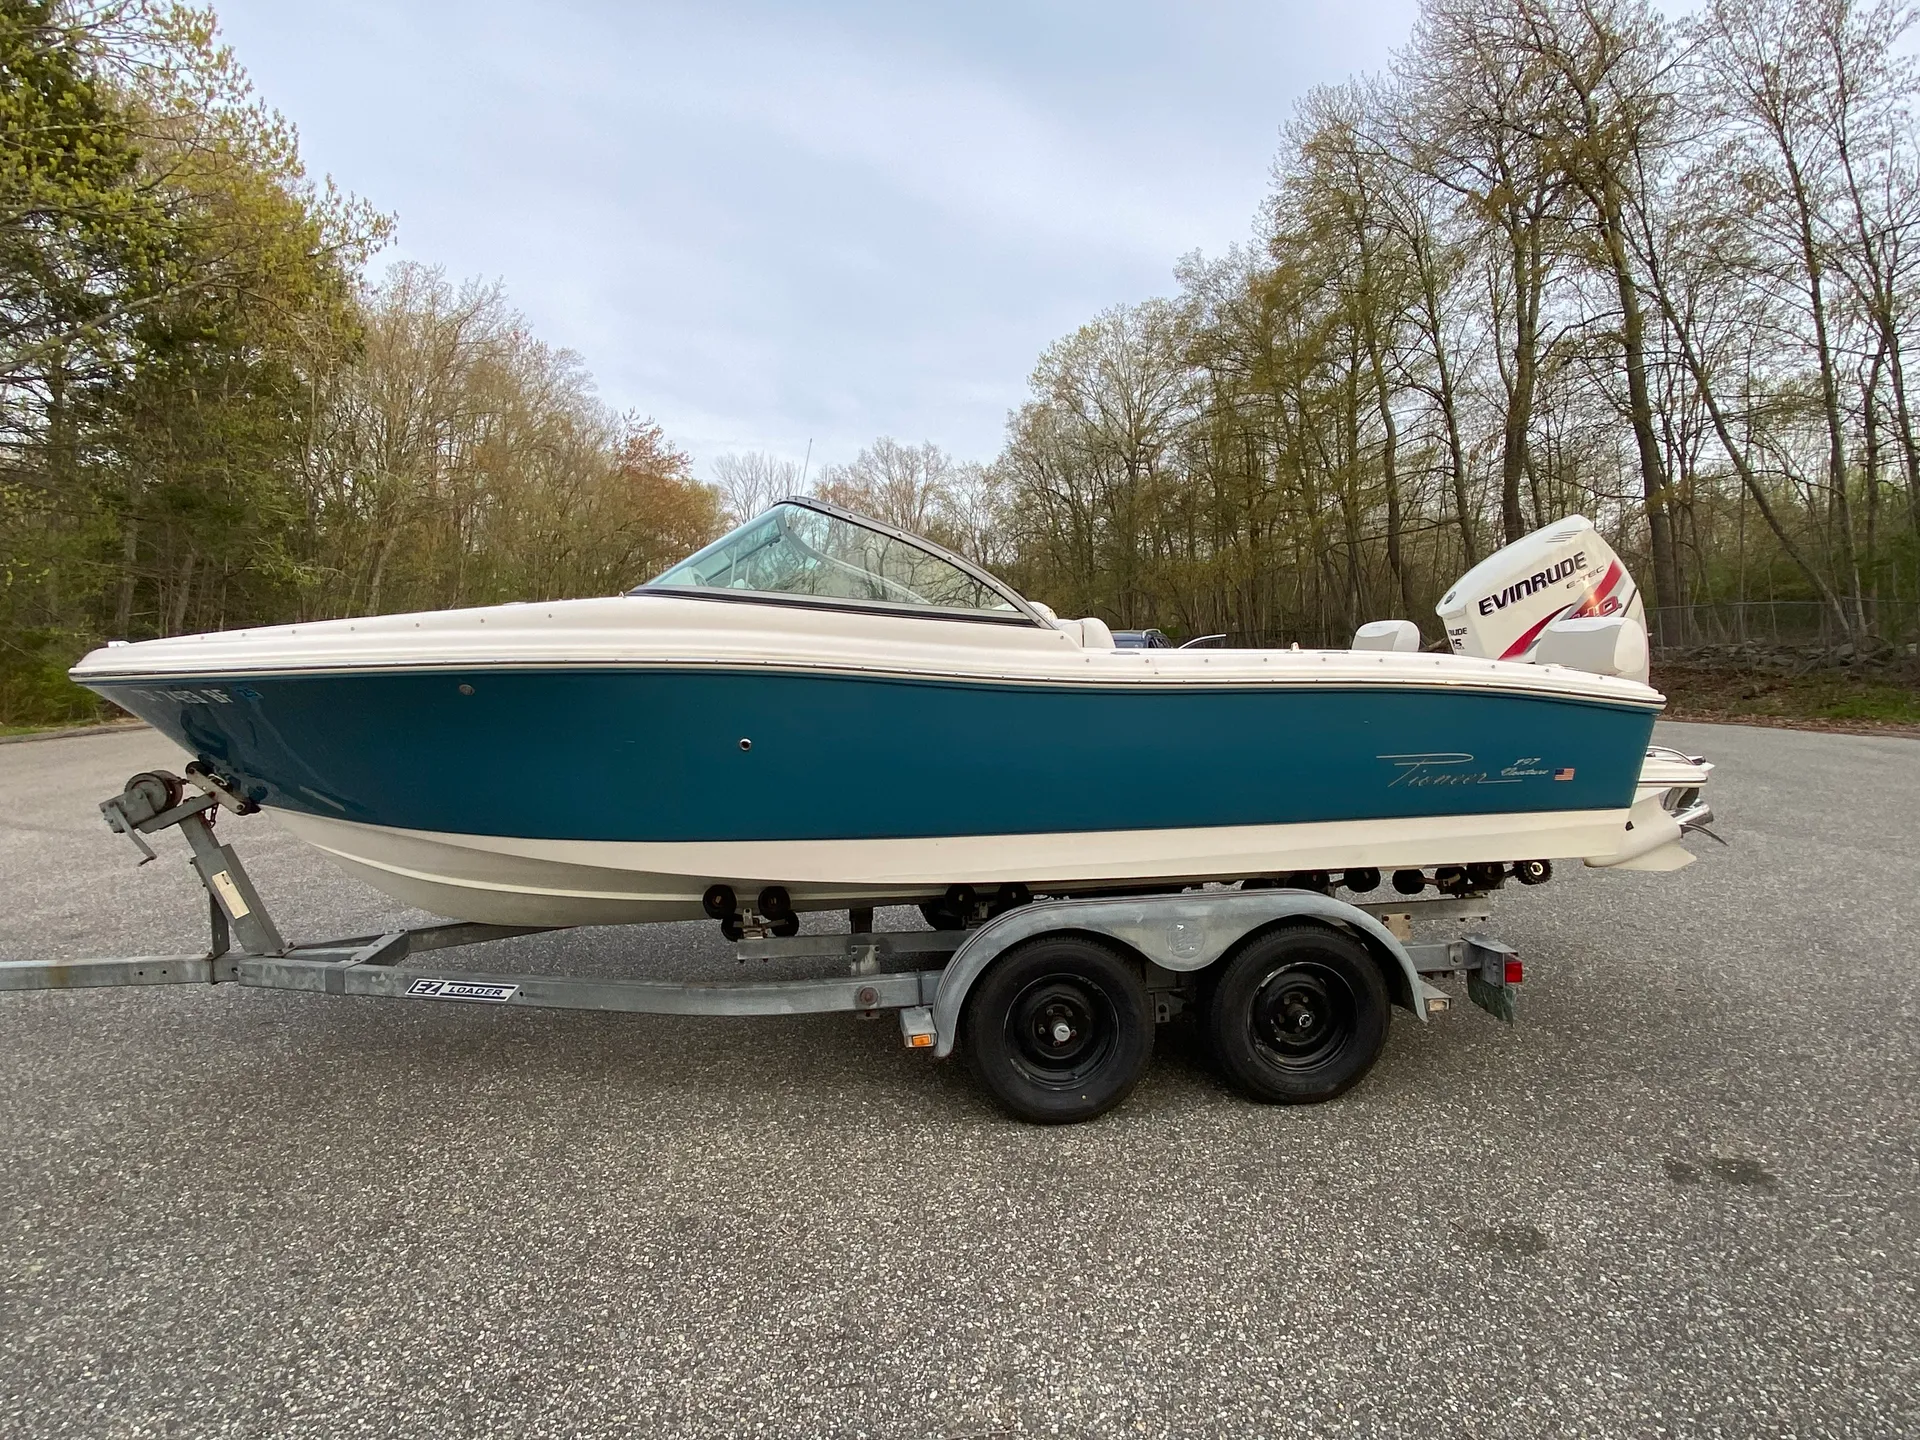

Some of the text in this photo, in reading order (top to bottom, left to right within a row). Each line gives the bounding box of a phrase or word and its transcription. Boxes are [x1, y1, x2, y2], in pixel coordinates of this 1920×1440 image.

[1478, 551, 1588, 616] EVINRUDE
[1376, 753, 1523, 788] Pioneer
[448, 986, 503, 996] LOADER
